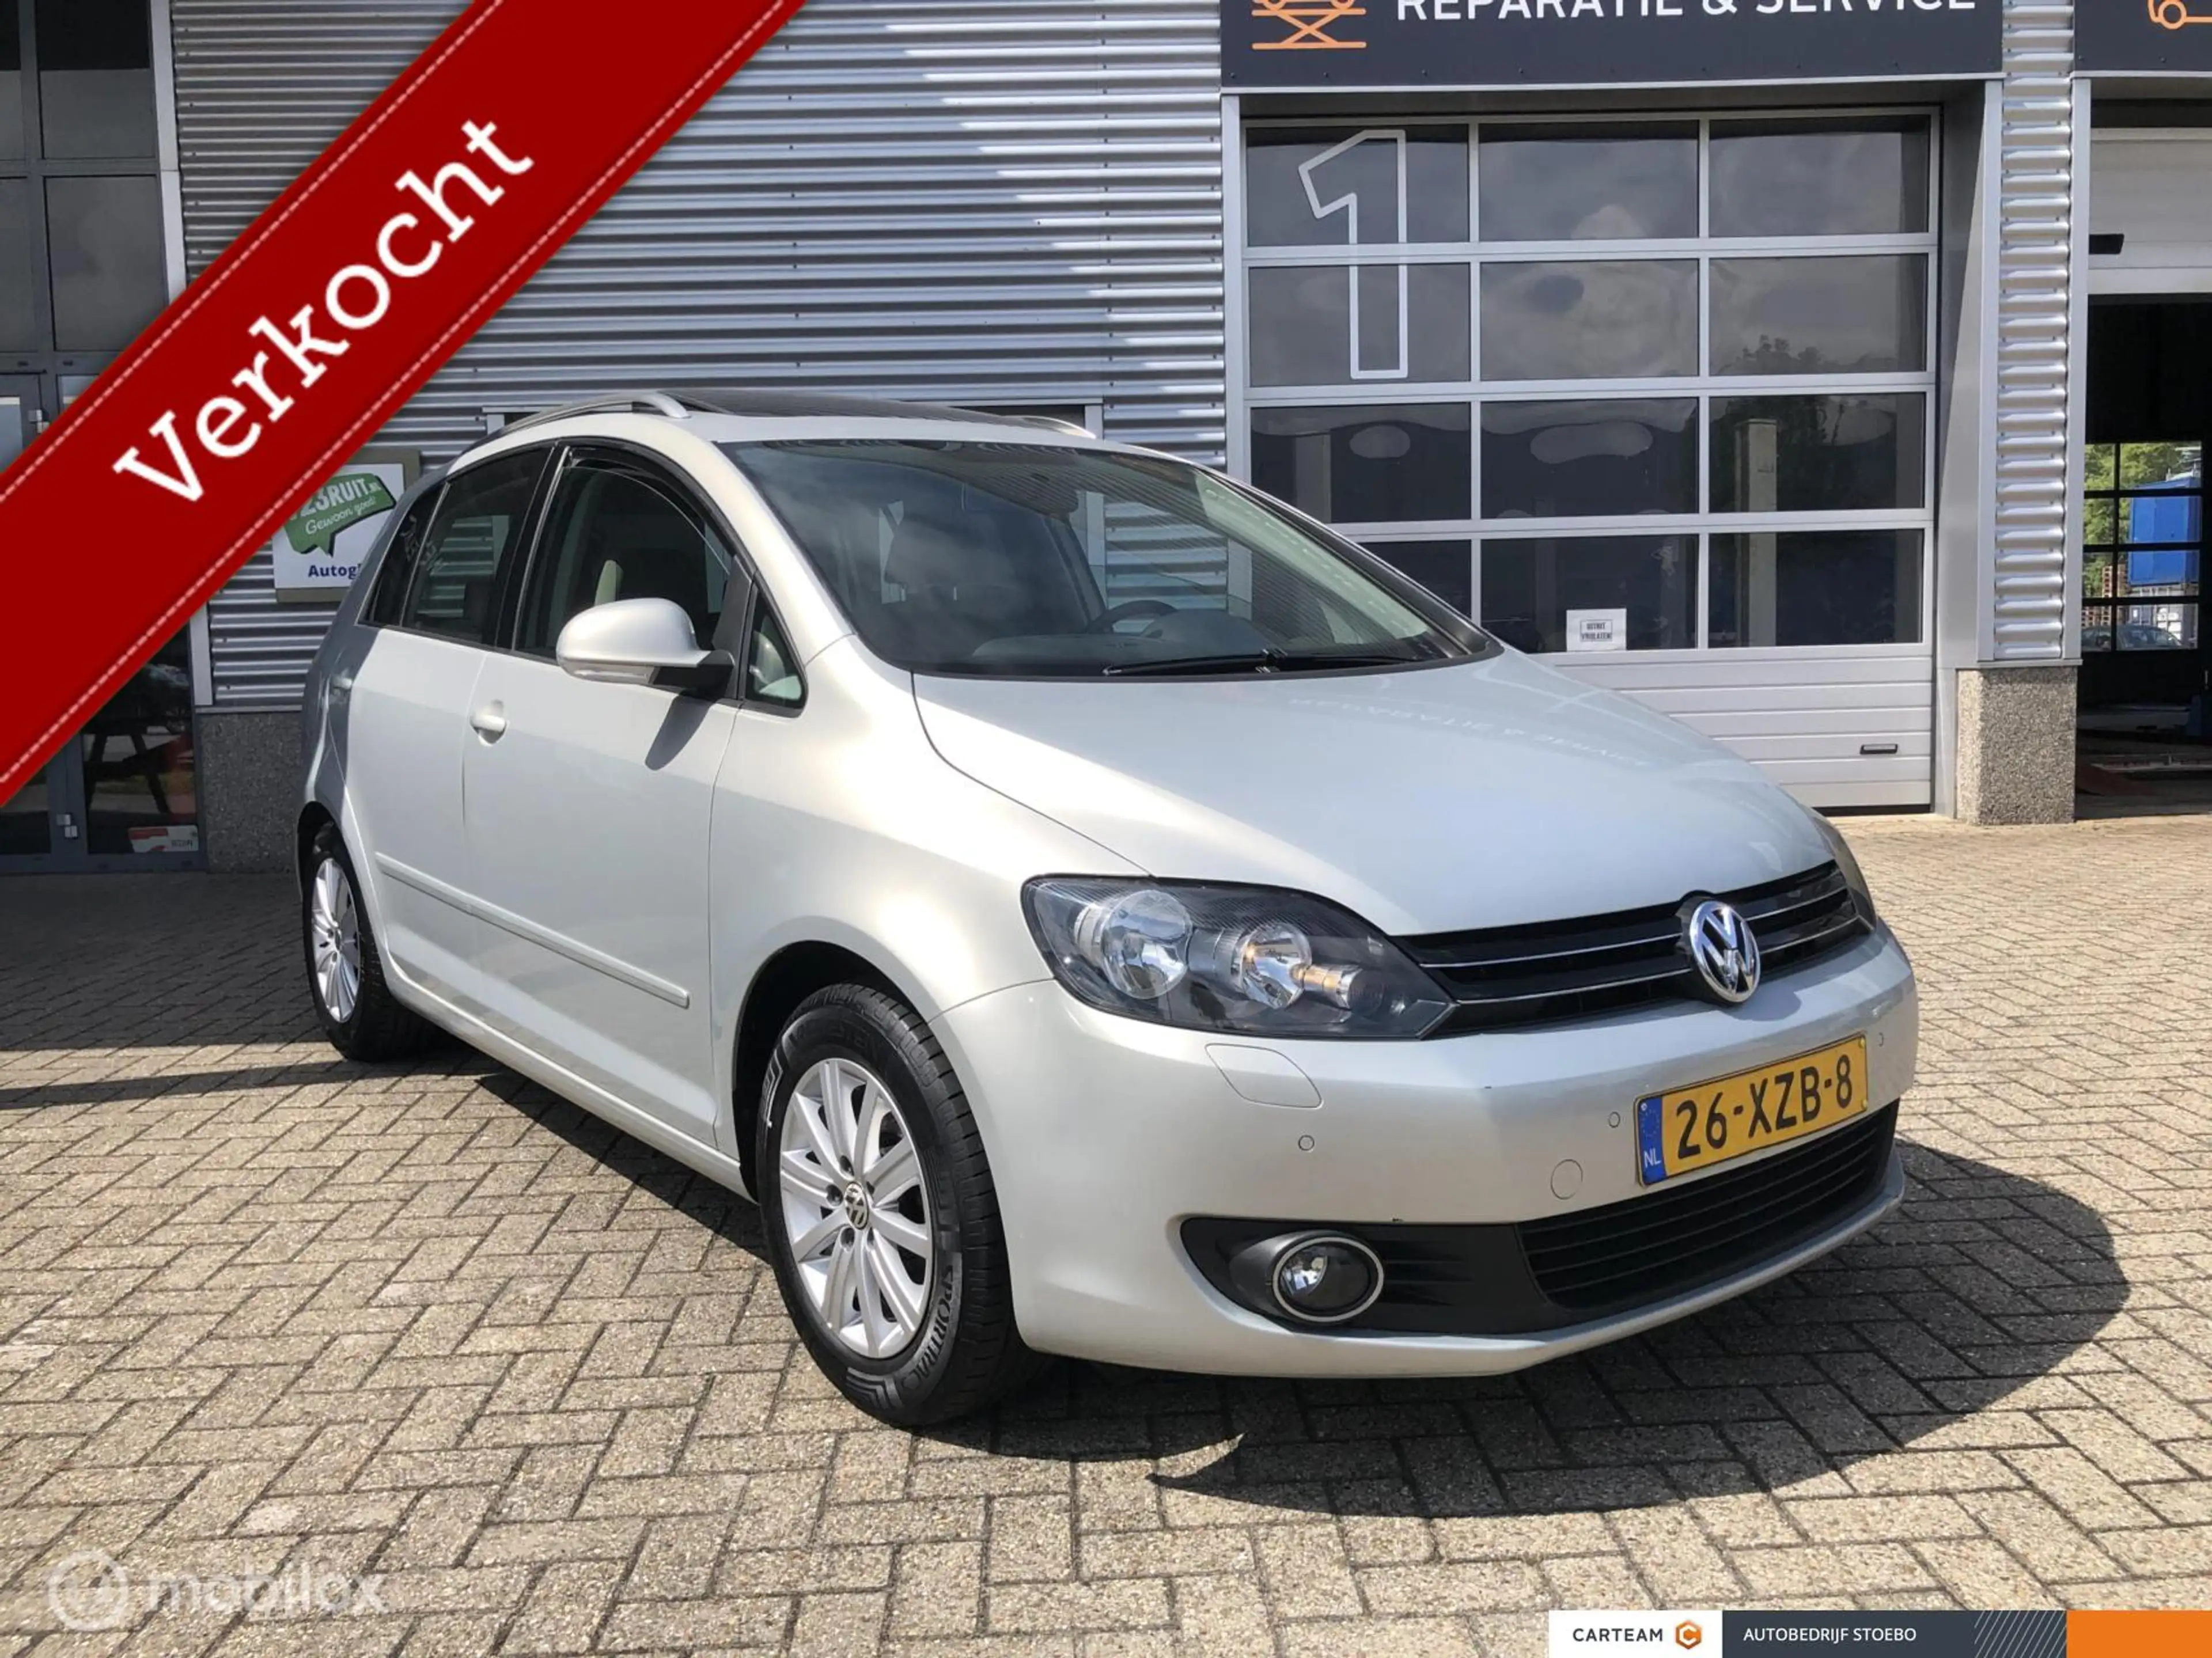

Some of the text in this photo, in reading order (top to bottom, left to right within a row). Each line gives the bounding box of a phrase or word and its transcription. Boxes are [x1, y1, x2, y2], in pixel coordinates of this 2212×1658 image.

[1298, 130, 1408, 380] 1
[305, 507, 353, 535] Gewoon
[1676, 1054, 1853, 1159] 26-XZB-8
[1643, 1147, 1662, 1168] NL
